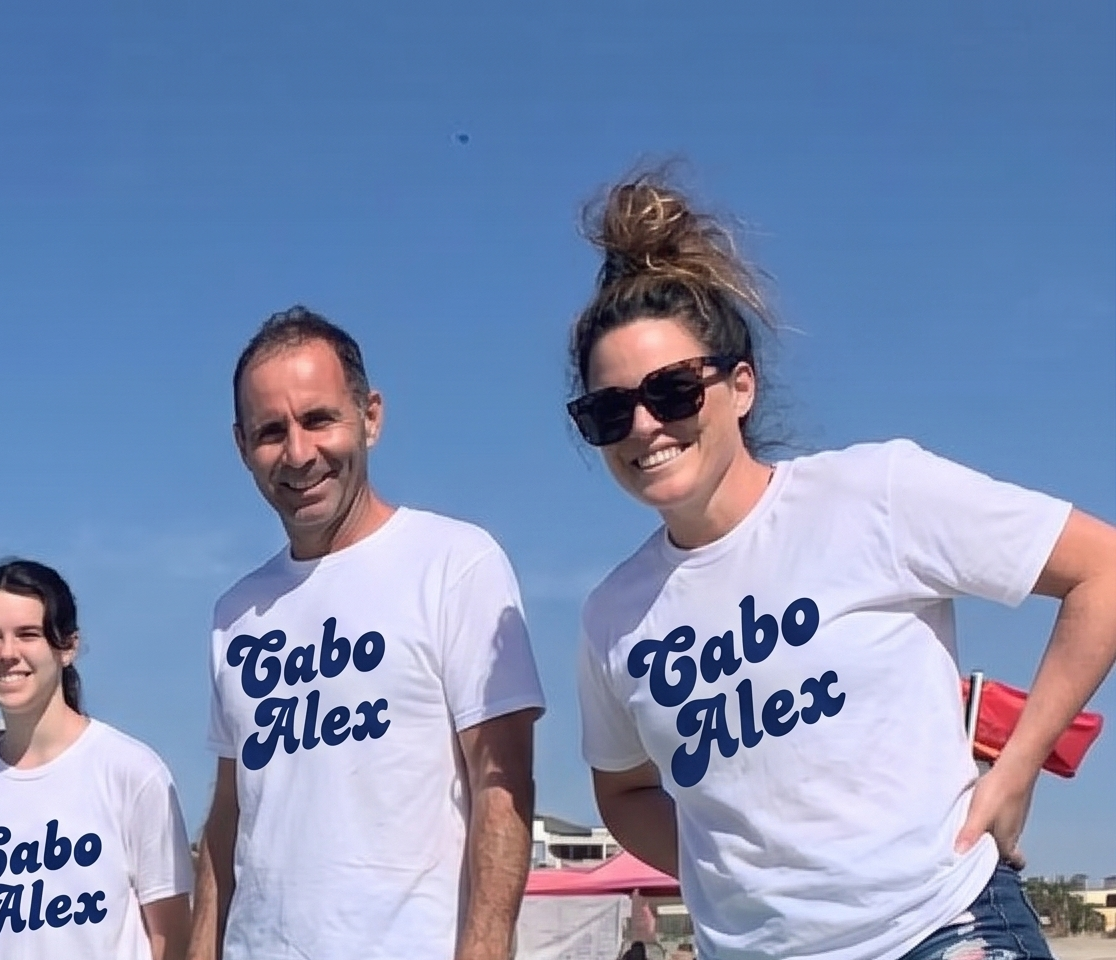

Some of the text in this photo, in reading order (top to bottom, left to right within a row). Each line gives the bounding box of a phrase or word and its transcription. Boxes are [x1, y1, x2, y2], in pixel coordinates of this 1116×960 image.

[226, 616, 386, 699] Cabo
[626, 594, 820, 708] Cabo
[241, 689, 391, 771] Alex
[670, 670, 846, 788] Alex
